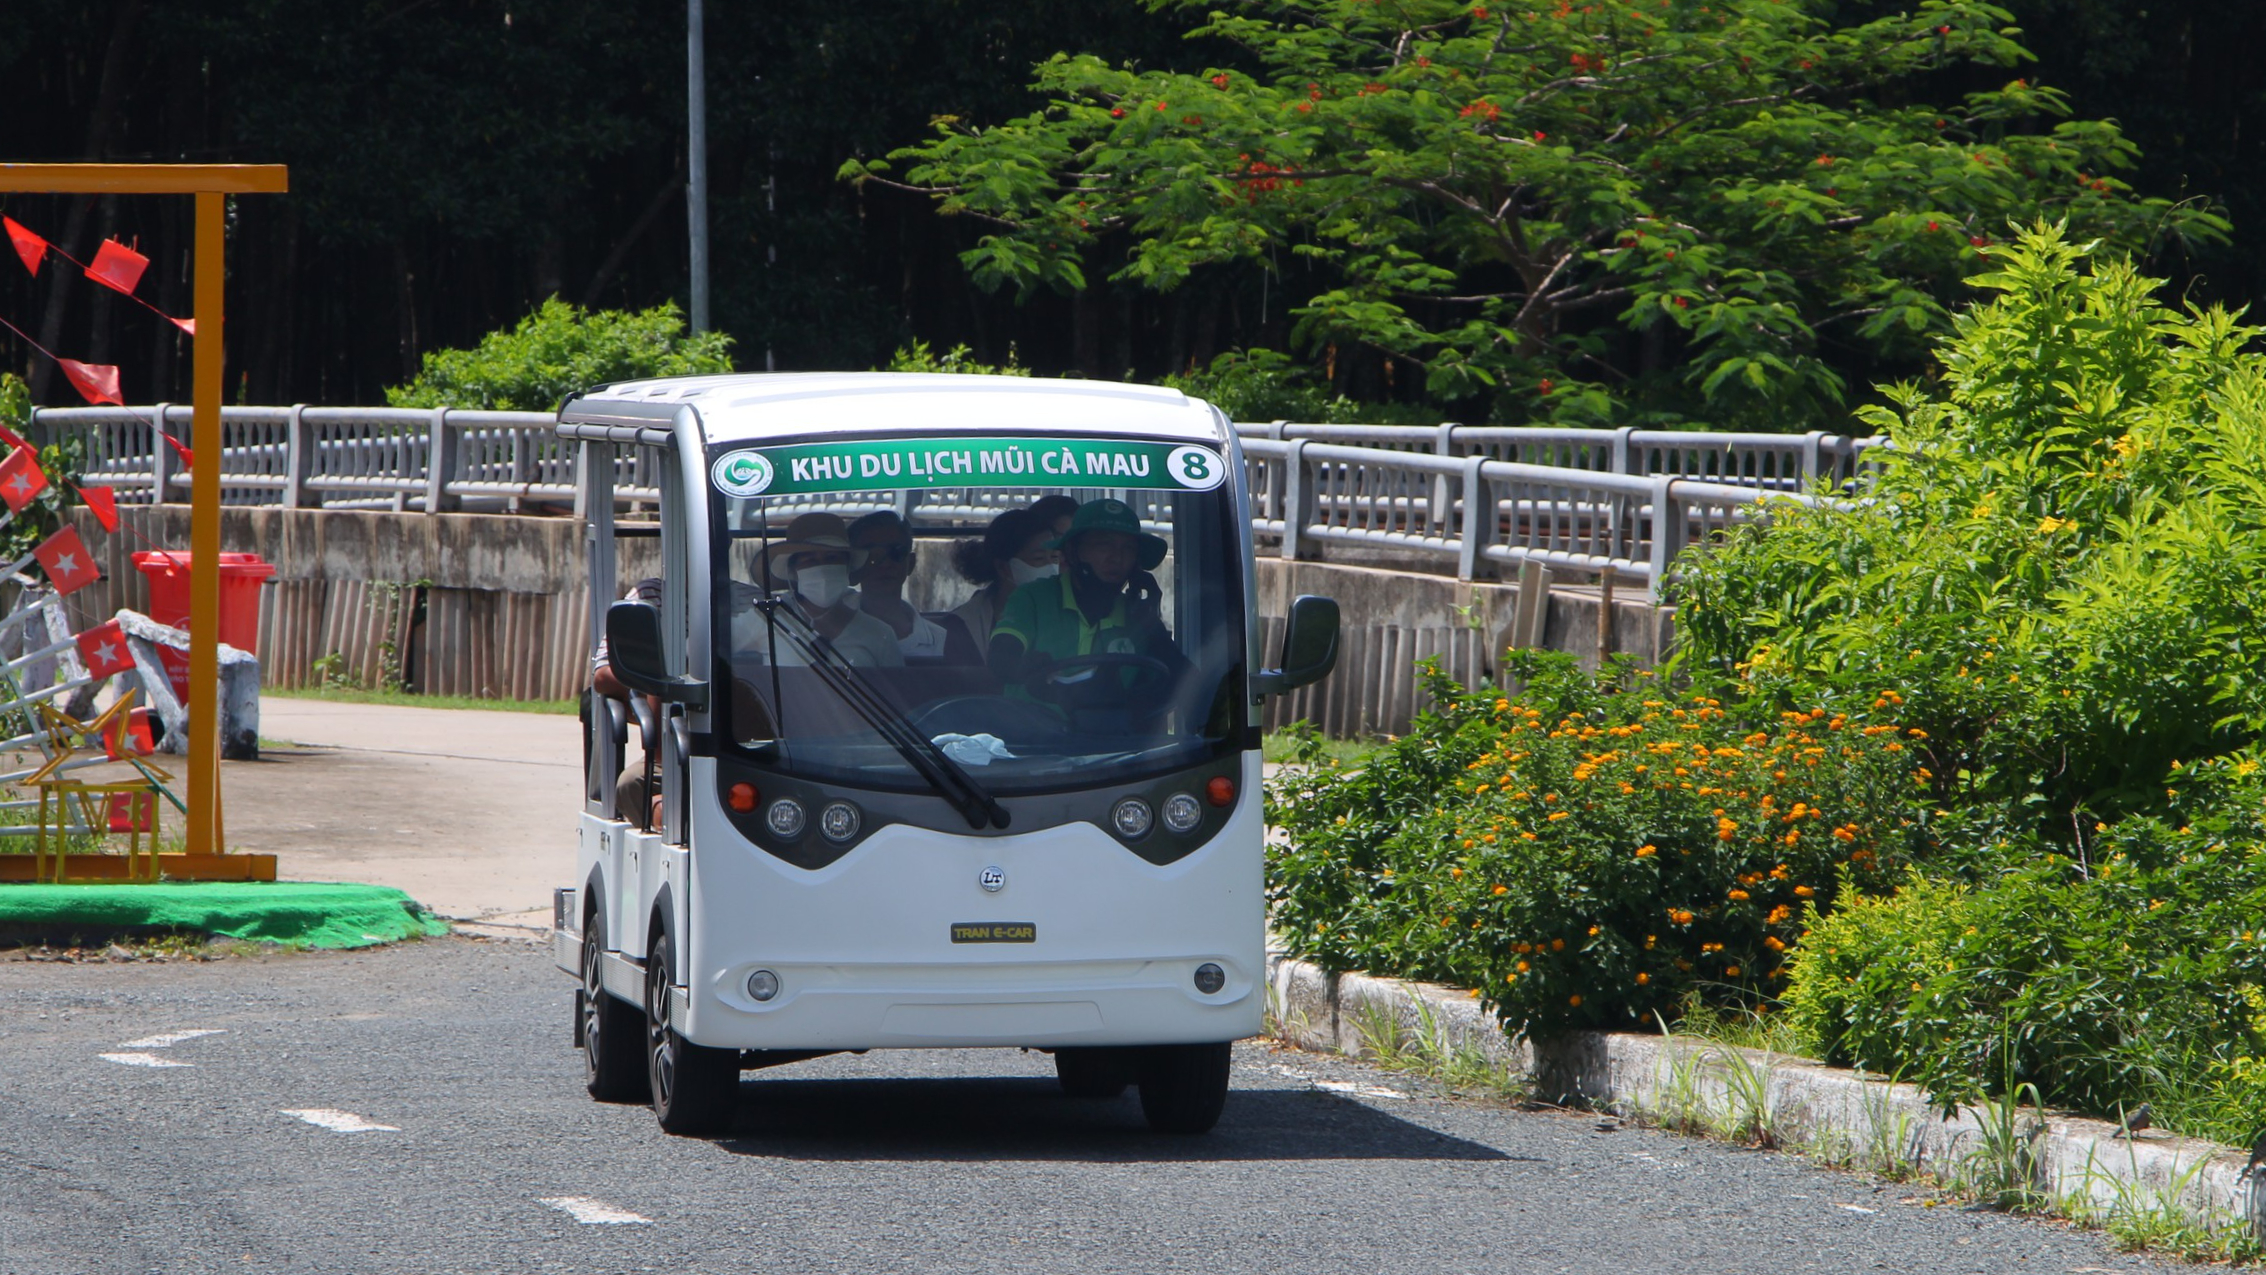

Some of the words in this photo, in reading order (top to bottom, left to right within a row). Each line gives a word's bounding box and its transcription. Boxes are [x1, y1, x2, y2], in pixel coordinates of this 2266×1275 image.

[791, 456, 852, 482] KHU
[859, 453, 901, 478] DU
[908, 451, 973, 483] LỊCH
[979, 445, 1035, 474] MŨI
[1041, 446, 1080, 475] CÀ
[1085, 452, 1150, 477] MAU
[1182, 452, 1210, 480] 8
[984, 872, 1002, 884] LT
[954, 927, 989, 939] TRAN
[993, 927, 1033, 938] E-CAR
